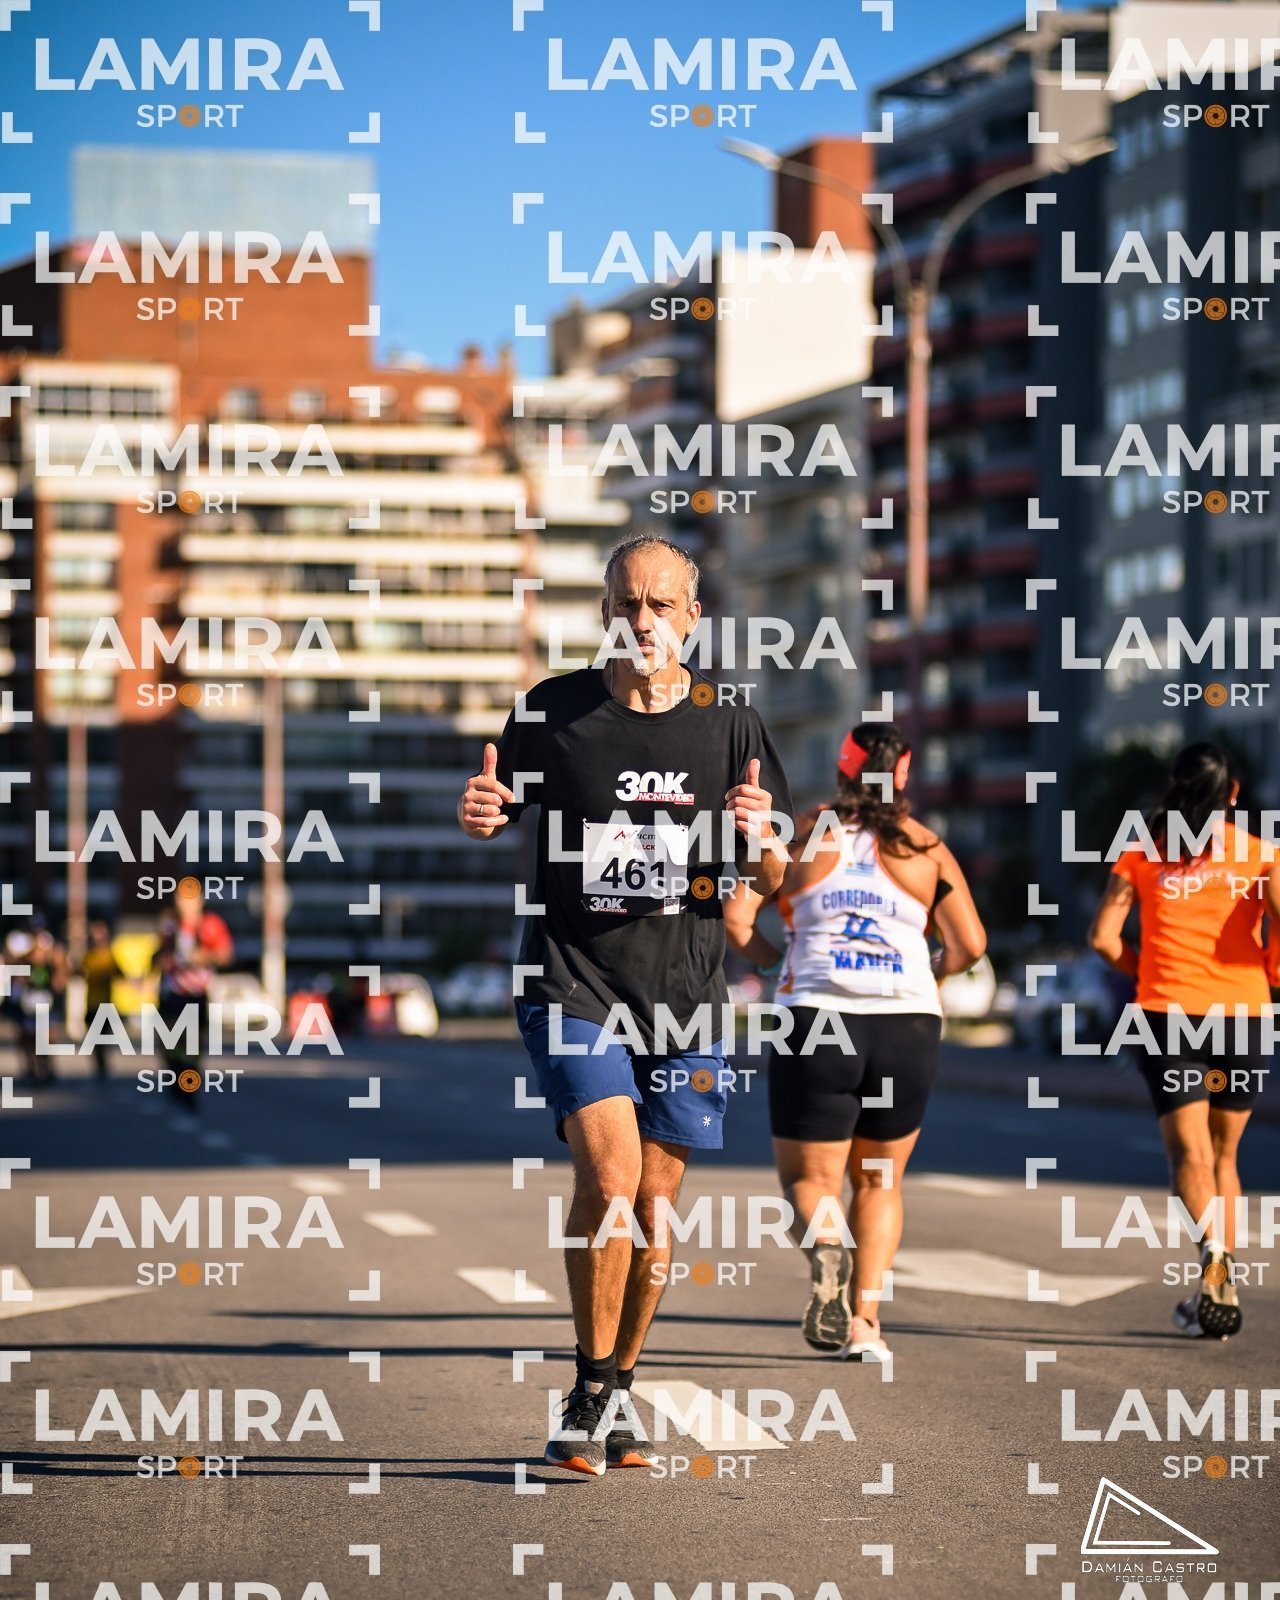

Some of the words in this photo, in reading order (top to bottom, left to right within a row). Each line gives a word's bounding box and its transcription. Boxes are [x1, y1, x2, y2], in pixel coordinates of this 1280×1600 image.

[615, 770, 690, 802] 30K
[600, 857, 665, 890] 461
[589, 896, 625, 911] 30K
